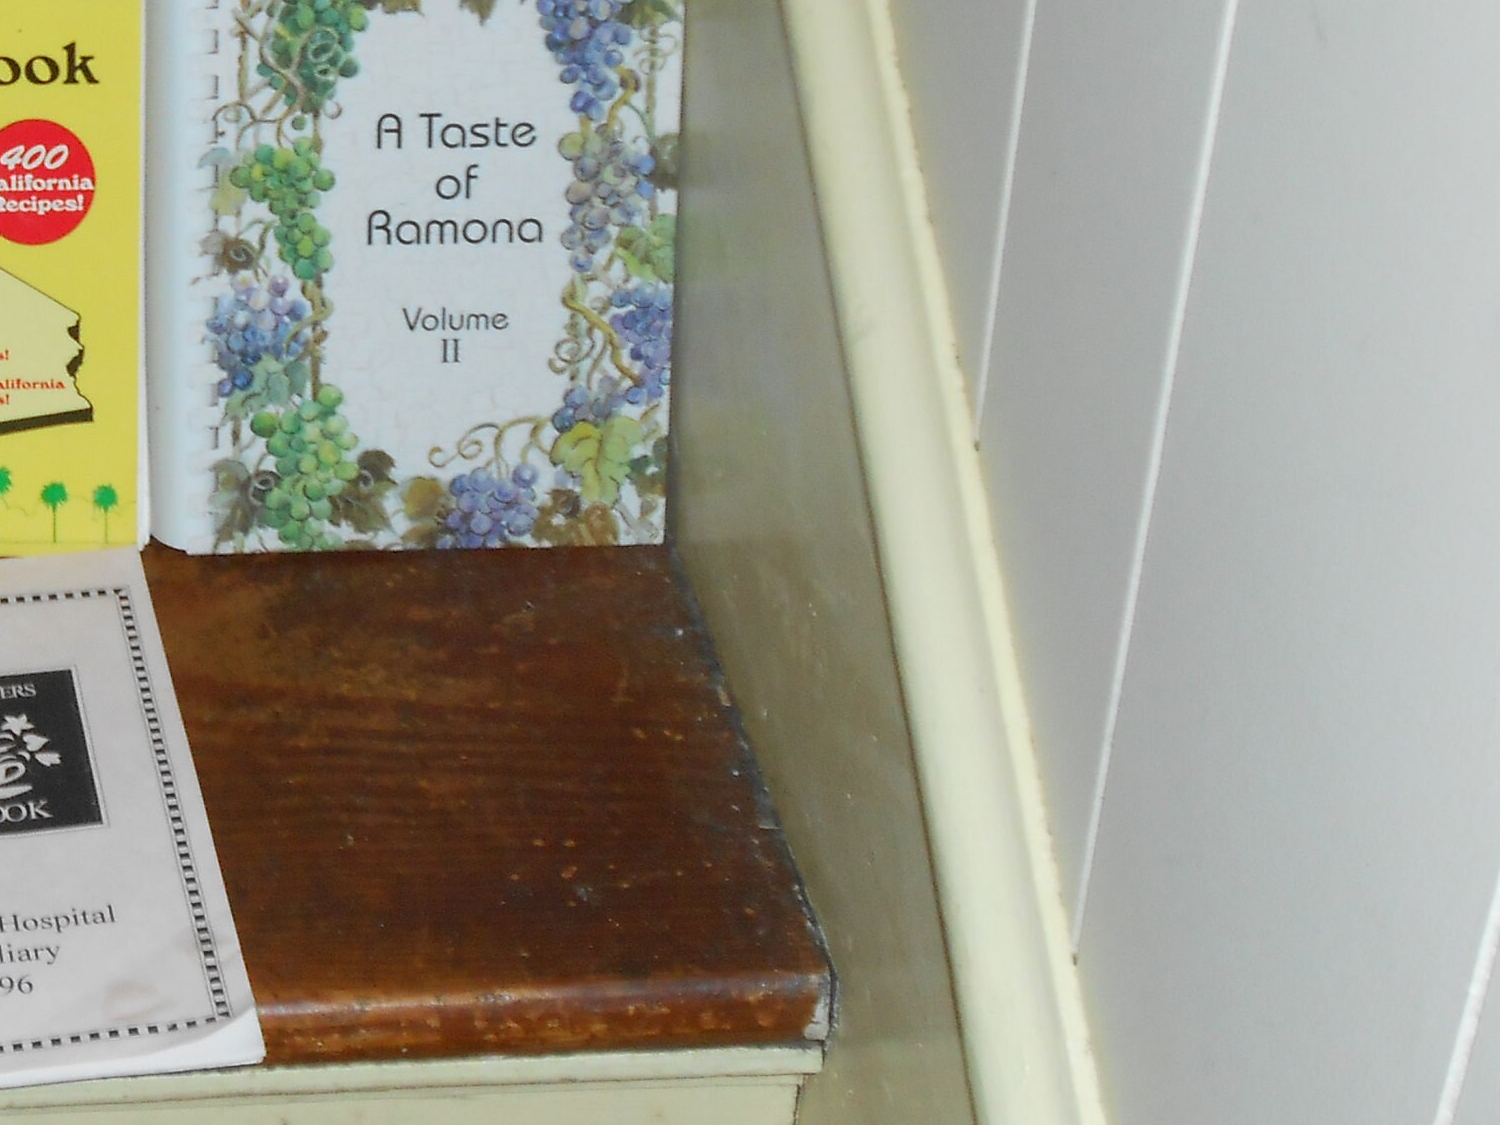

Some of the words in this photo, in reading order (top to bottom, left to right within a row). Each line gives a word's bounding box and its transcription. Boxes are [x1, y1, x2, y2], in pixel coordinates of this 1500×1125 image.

[375, 113, 402, 149] A
[420, 112, 537, 149] Taste
[0, 144, 70, 171] 400
[435, 165, 479, 201] of
[366, 210, 544, 246] Ramona
[402, 306, 509, 332] Volume
[440, 337, 461, 364] II
